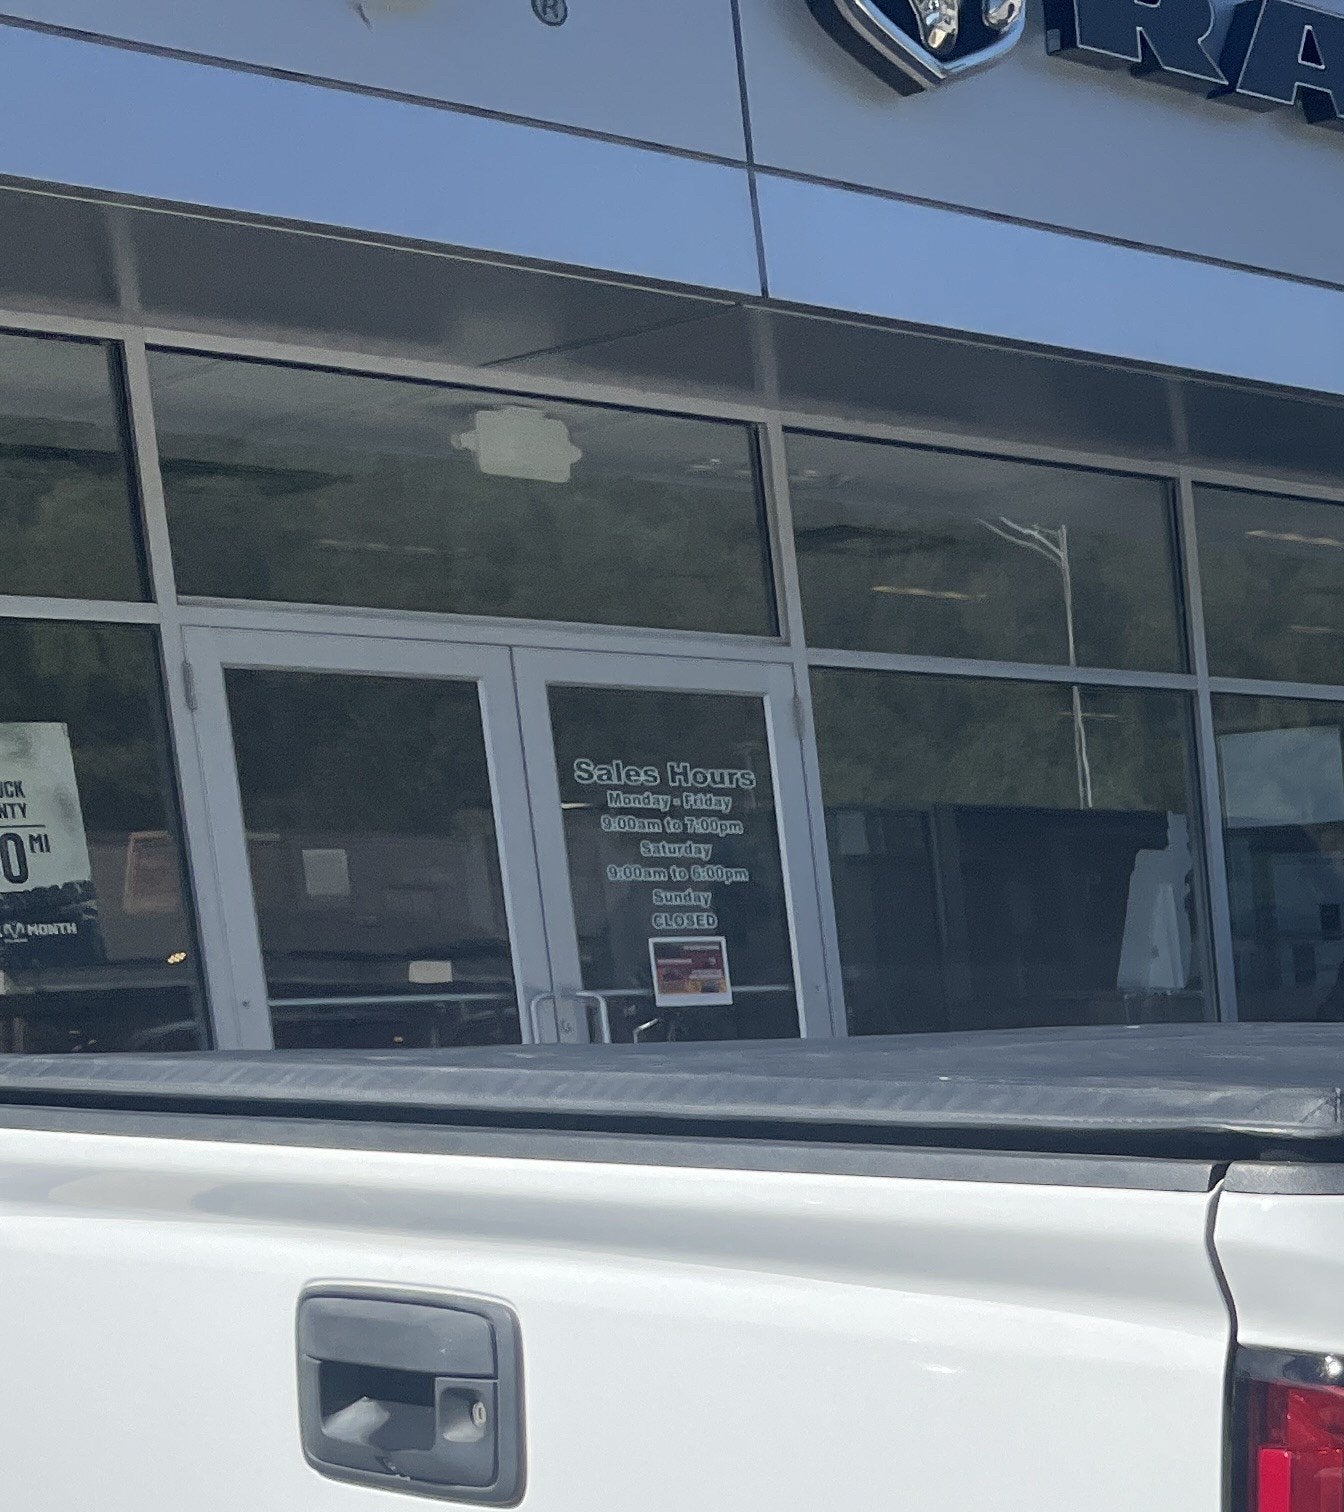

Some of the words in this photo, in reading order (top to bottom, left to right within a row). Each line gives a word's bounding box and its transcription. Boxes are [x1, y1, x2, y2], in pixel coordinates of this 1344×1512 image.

[573, 758, 661, 786] Sales
[666, 761, 757, 789] Hours
[606, 790, 671, 812] Monday
[682, 792, 733, 814] Friday
[600, 814, 663, 833] 9:00am
[664, 816, 683, 833] to
[684, 816, 744, 837] 7:00pm
[28, 833, 51, 854] MI
[639, 840, 713, 861] Saturday
[606, 864, 669, 882] 9:00am
[669, 865, 689, 882] to
[690, 865, 750, 885] 6:00pm
[652, 888, 713, 908] Sunday
[27, 922, 78, 936] MONTH
[651, 912, 719, 930] CLOSED
